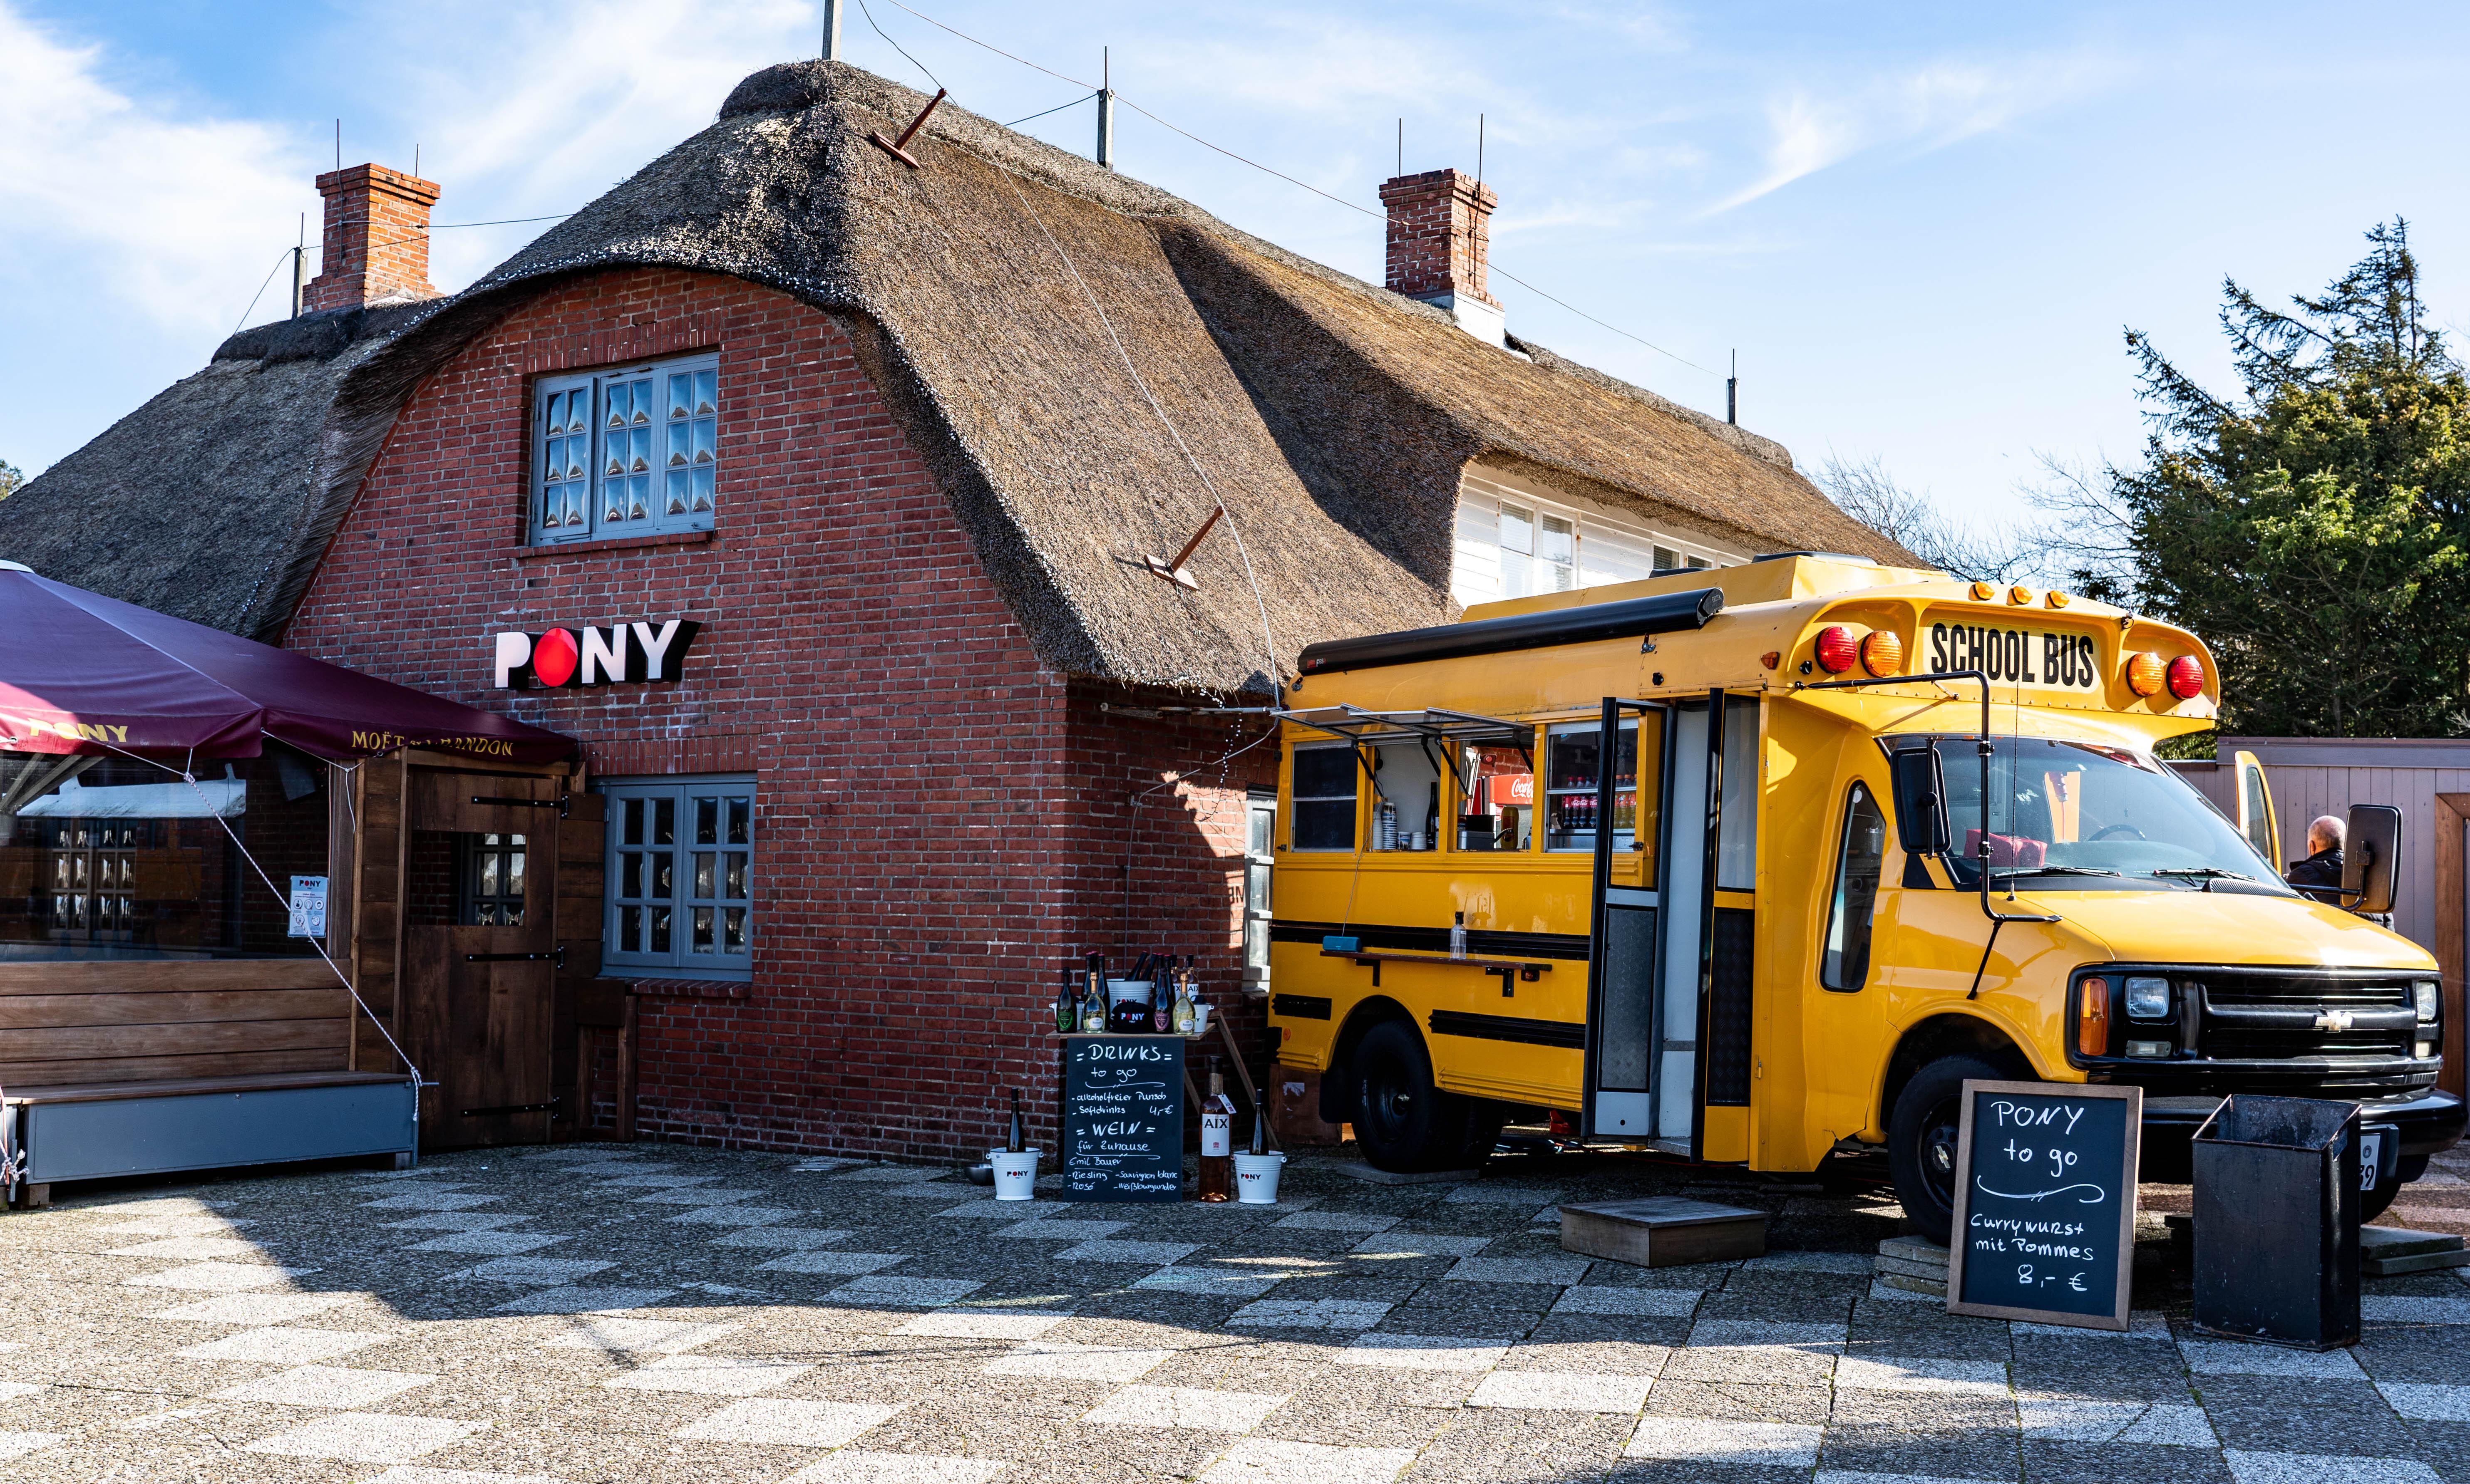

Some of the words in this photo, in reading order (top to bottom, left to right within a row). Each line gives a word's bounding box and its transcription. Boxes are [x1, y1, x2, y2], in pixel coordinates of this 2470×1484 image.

[495, 619, 683, 688] PONY
[1931, 622, 2035, 683] SCHOOL
[2044, 633, 2093, 688] BUS
[27, 718, 128, 742] PONY
[1088, 1044, 1161, 1061] DRINKS
[1091, 1067, 1106, 1077] to
[1116, 1068, 1137, 1083] go
[1077, 1092, 1132, 1103] alkoholfreier
[1135, 1091, 1167, 1101] Punsch
[1204, 1118, 1228, 1128] AIX
[1991, 1101, 2084, 1135] PONY
[1092, 1121, 1141, 1137] WEIN
[1077, 1140, 1094, 1152] für
[1100, 1140, 1151, 1151] Zuhause
[1069, 1157, 1091, 1165] Emil
[1093, 1157, 1122, 1166] Bauer
[2003, 1138, 2033, 1162] to
[2049, 1149, 2078, 1177] go
[1976, 1238, 2006, 1252] mit
[2011, 1238, 2094, 1261] Pommes
